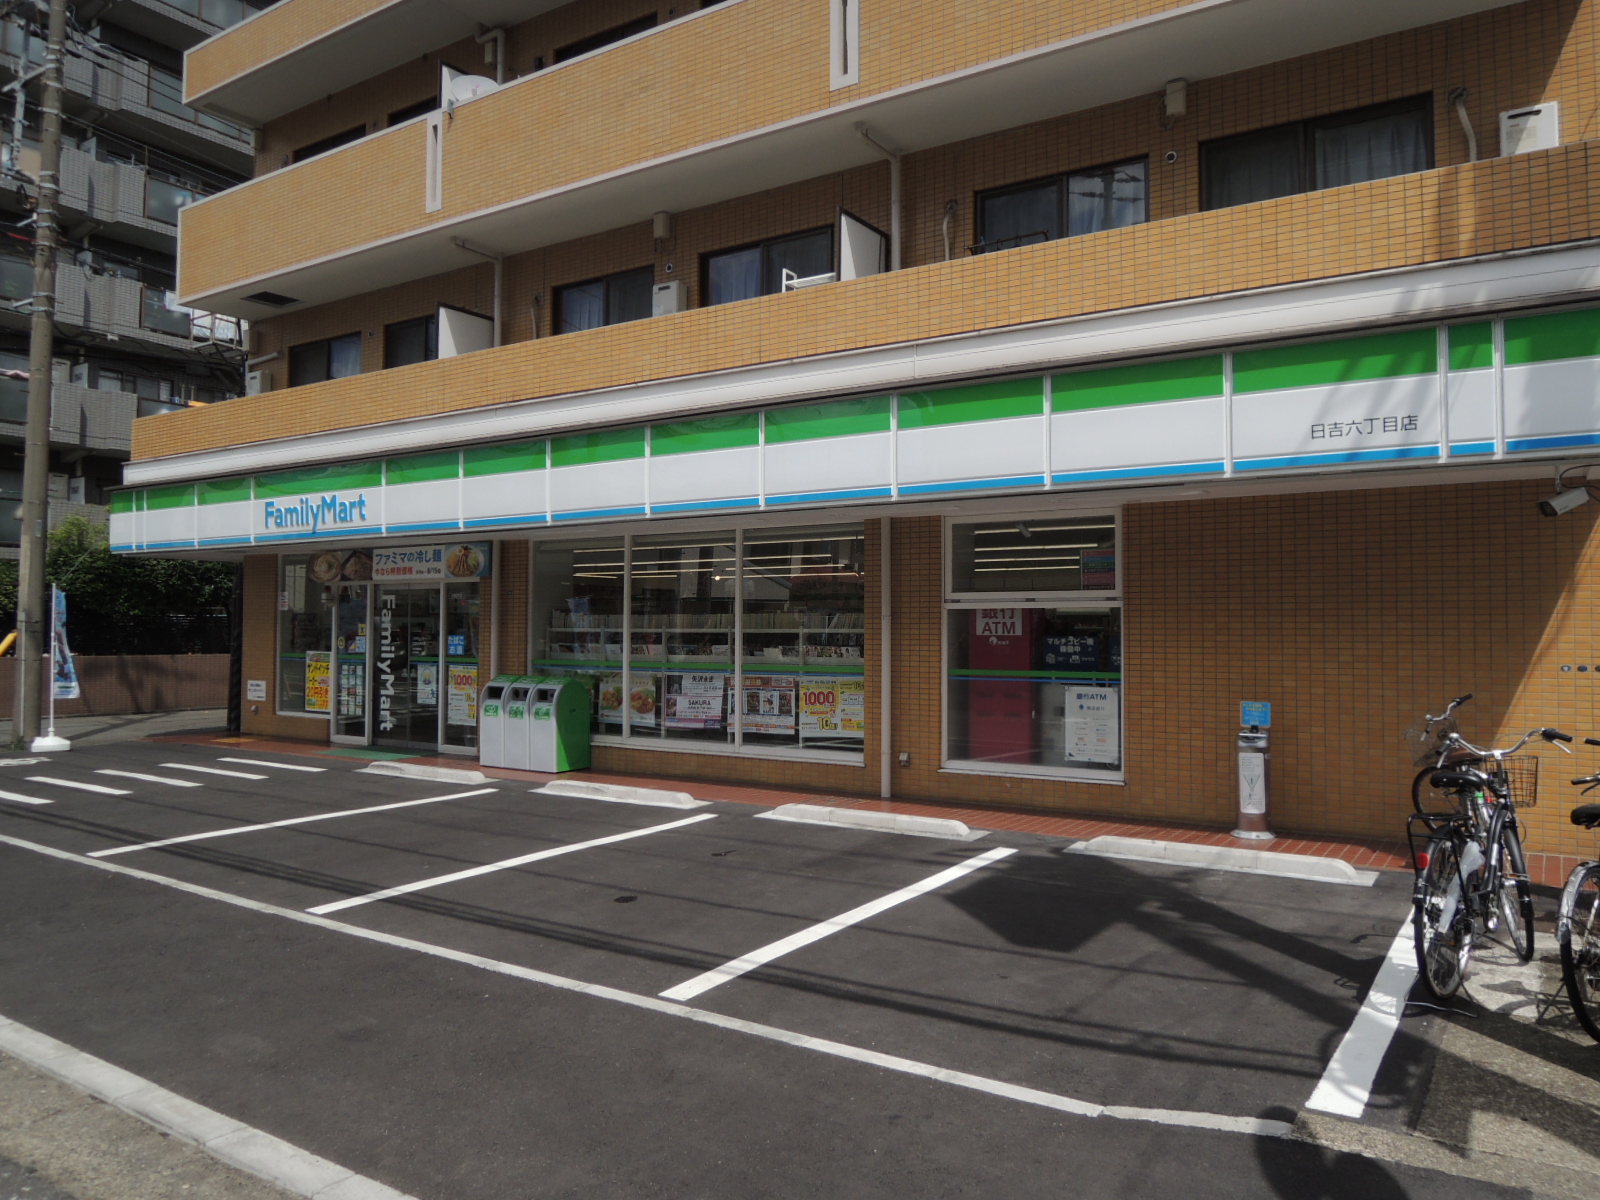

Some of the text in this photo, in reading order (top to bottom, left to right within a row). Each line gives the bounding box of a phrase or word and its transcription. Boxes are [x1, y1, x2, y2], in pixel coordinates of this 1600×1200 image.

[1310, 415, 1418, 440] 日吉六丁目店
[264, 492, 366, 534] FamilyMart
[375, 549, 442, 565] ファミマの冷し麺
[982, 621, 1016, 634] ATM
[447, 635, 464, 645] たばこ
[377, 594, 396, 731] FamilyMart
[453, 674, 473, 686] 1000
[803, 690, 836, 706] 1000
